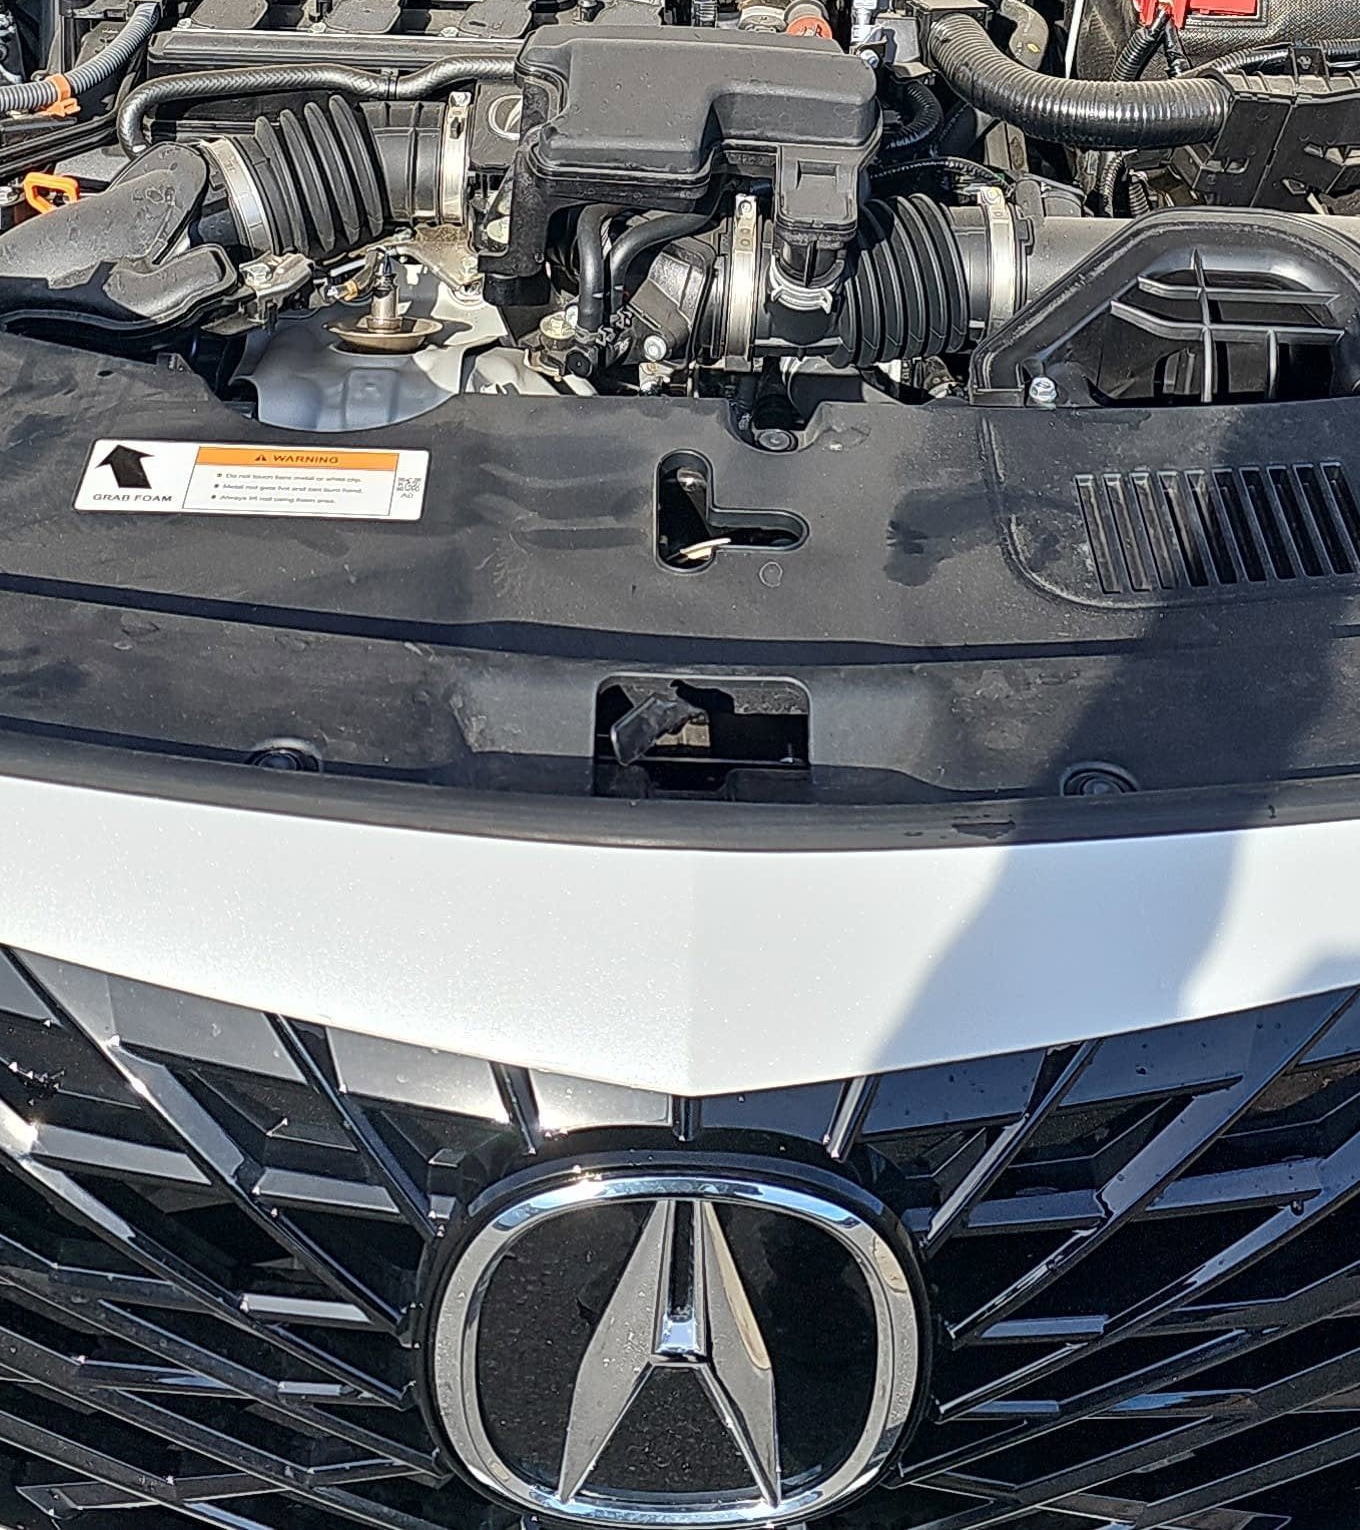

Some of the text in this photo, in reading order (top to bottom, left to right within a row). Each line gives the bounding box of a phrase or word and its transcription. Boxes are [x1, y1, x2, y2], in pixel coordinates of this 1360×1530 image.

[273, 454, 339, 464] WARNING
[93, 493, 172, 502] GRAB FOAM
